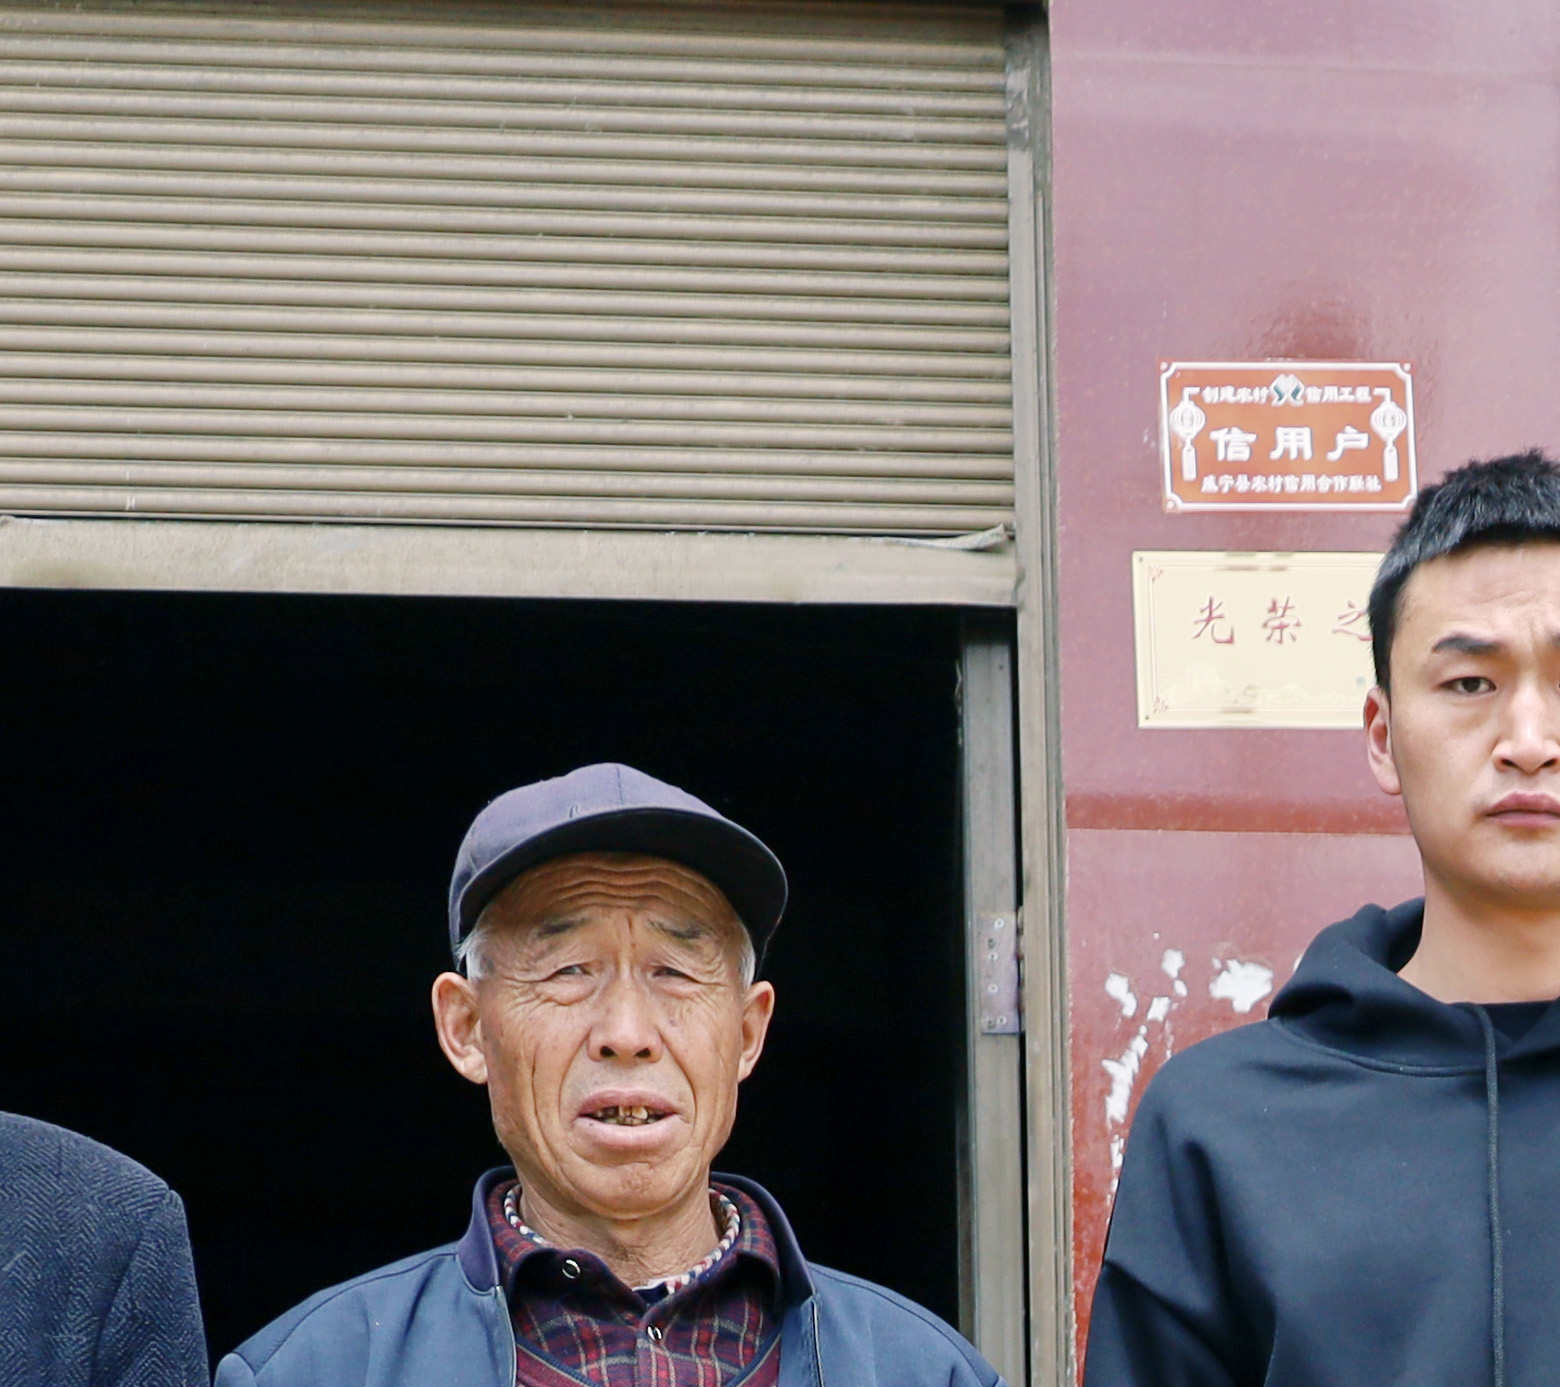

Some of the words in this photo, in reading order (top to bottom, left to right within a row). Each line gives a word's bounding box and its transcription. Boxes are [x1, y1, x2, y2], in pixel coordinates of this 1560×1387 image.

[1202, 385, 1269, 404] 创建农村
[1306, 385, 1372, 403] 信用工程
[1209, 425, 1370, 462] 信用户
[1192, 595, 1373, 645] 光荣之
